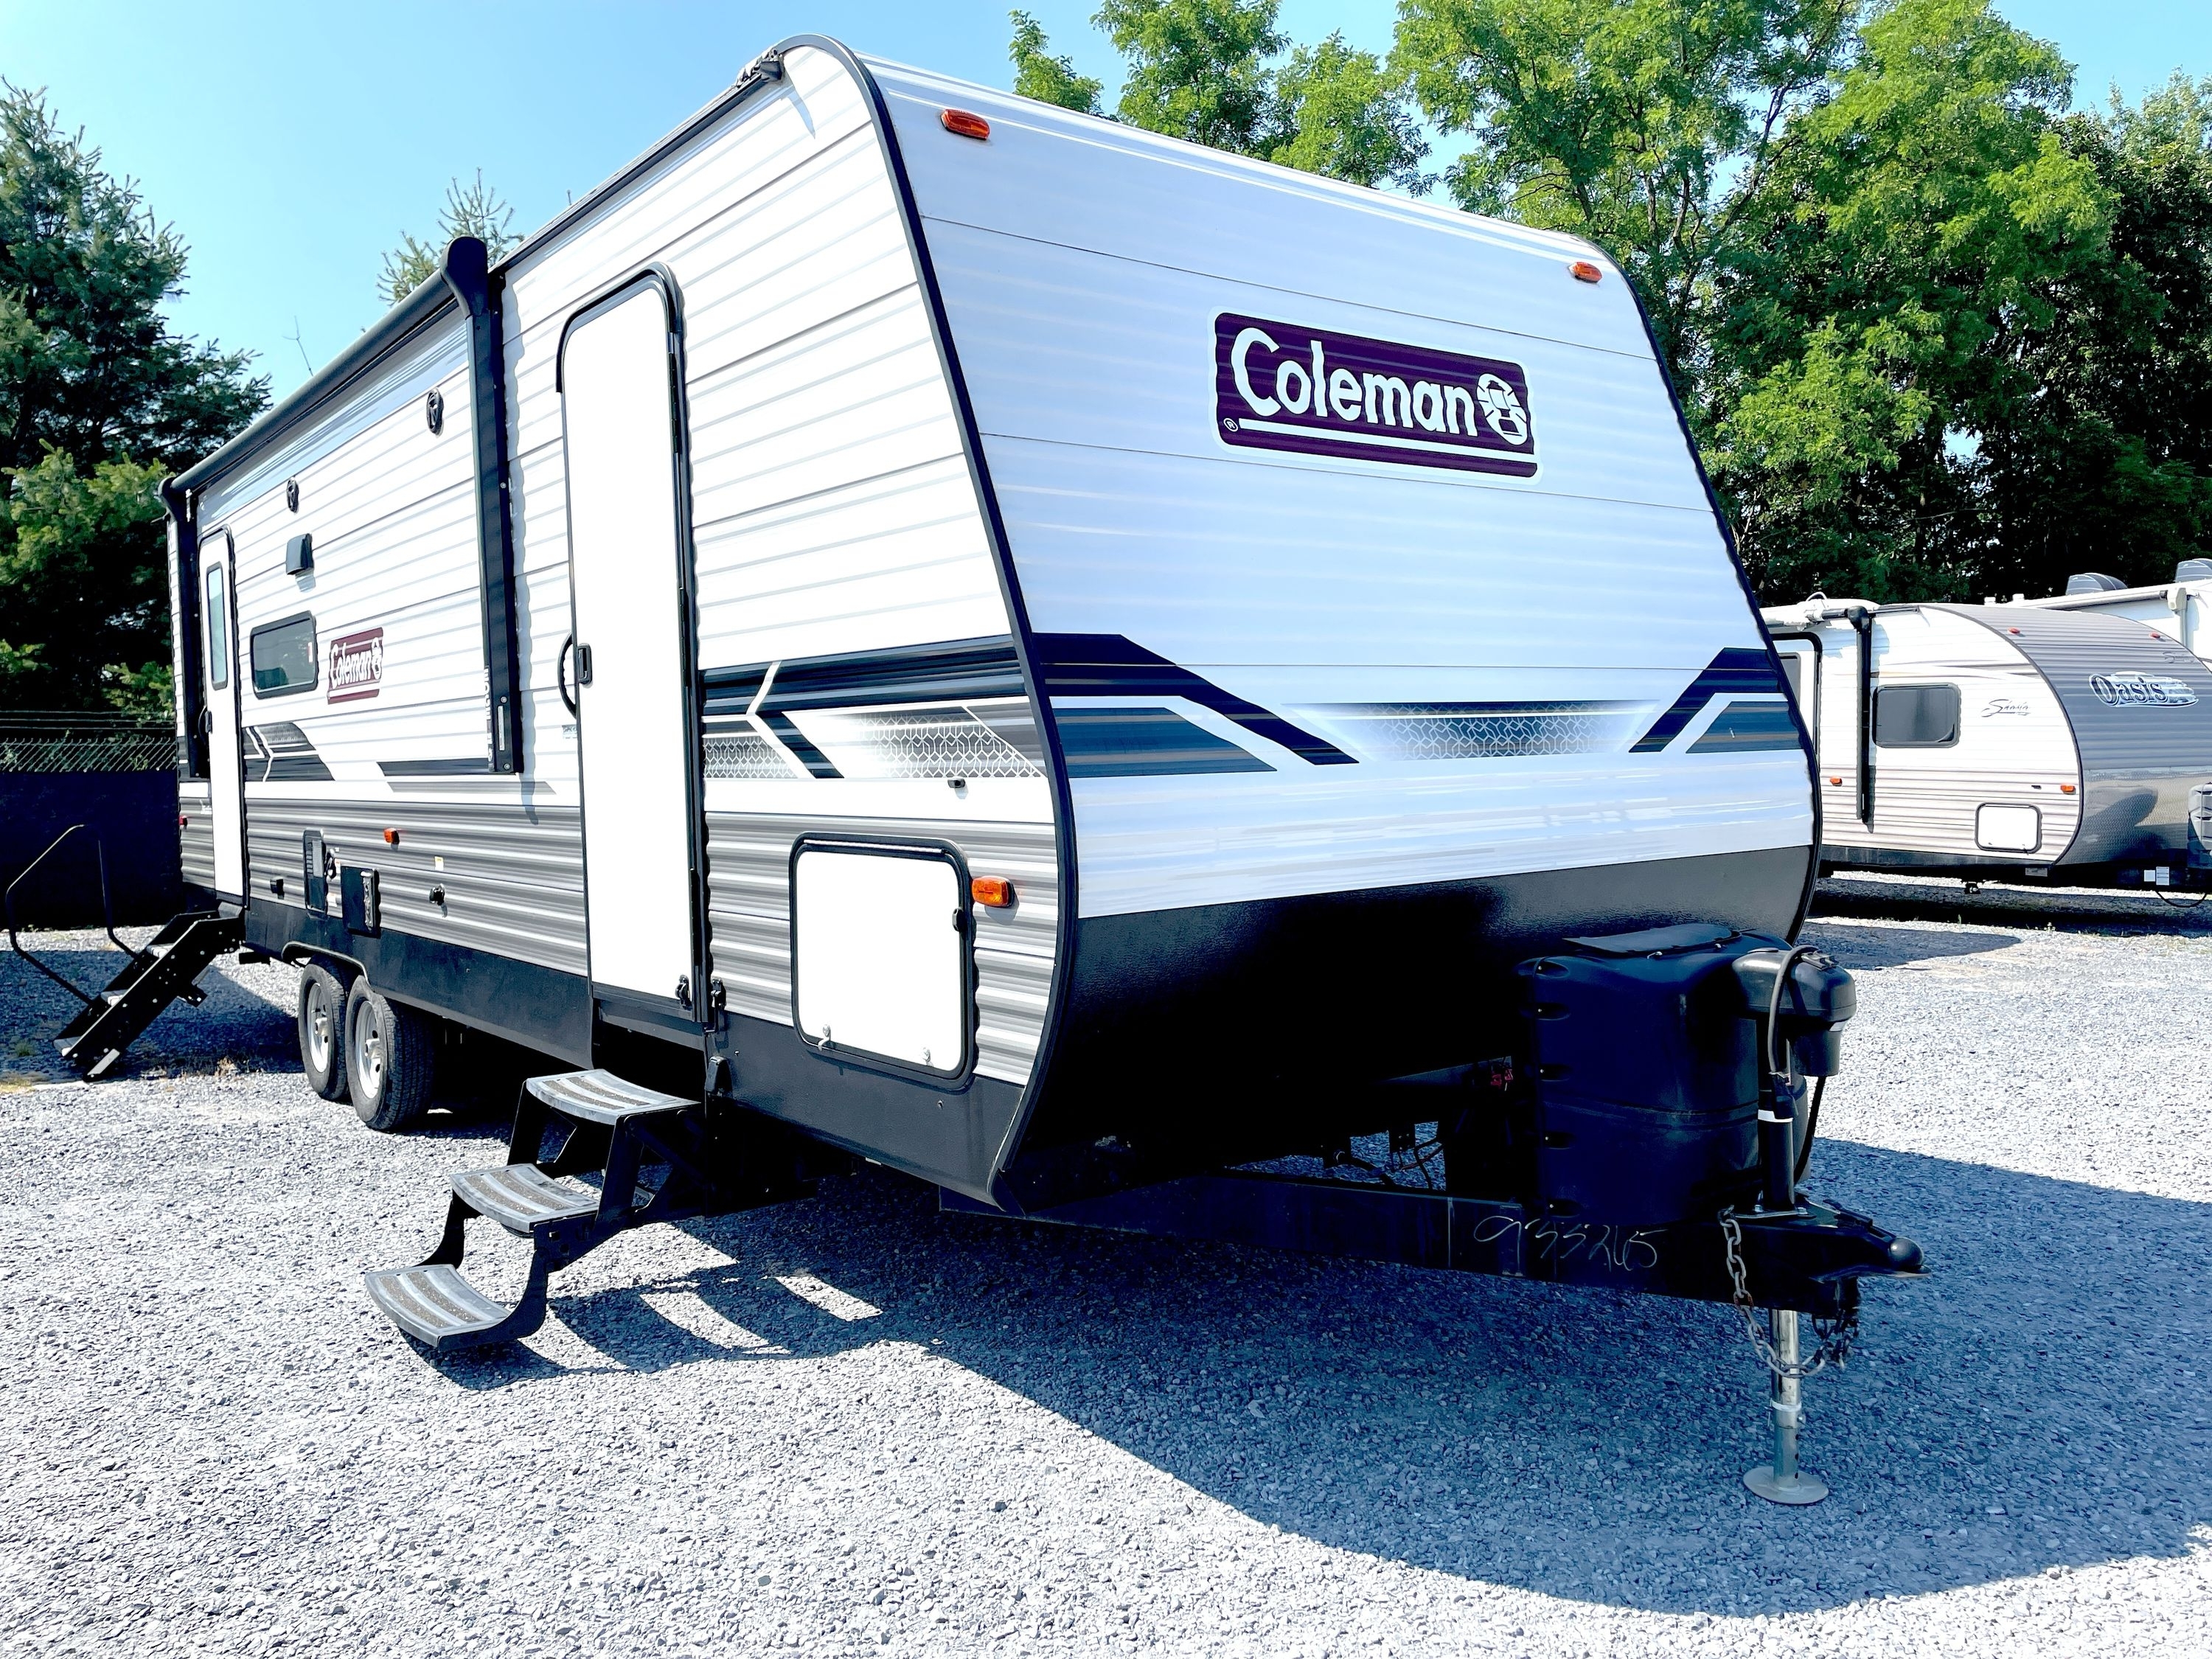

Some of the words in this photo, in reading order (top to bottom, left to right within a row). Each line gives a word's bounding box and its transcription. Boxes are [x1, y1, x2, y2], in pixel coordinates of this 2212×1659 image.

[1231, 327, 1478, 437] Coleman
[330, 642, 372, 689] Coleman
[2089, 674, 2168, 706] Oasis
